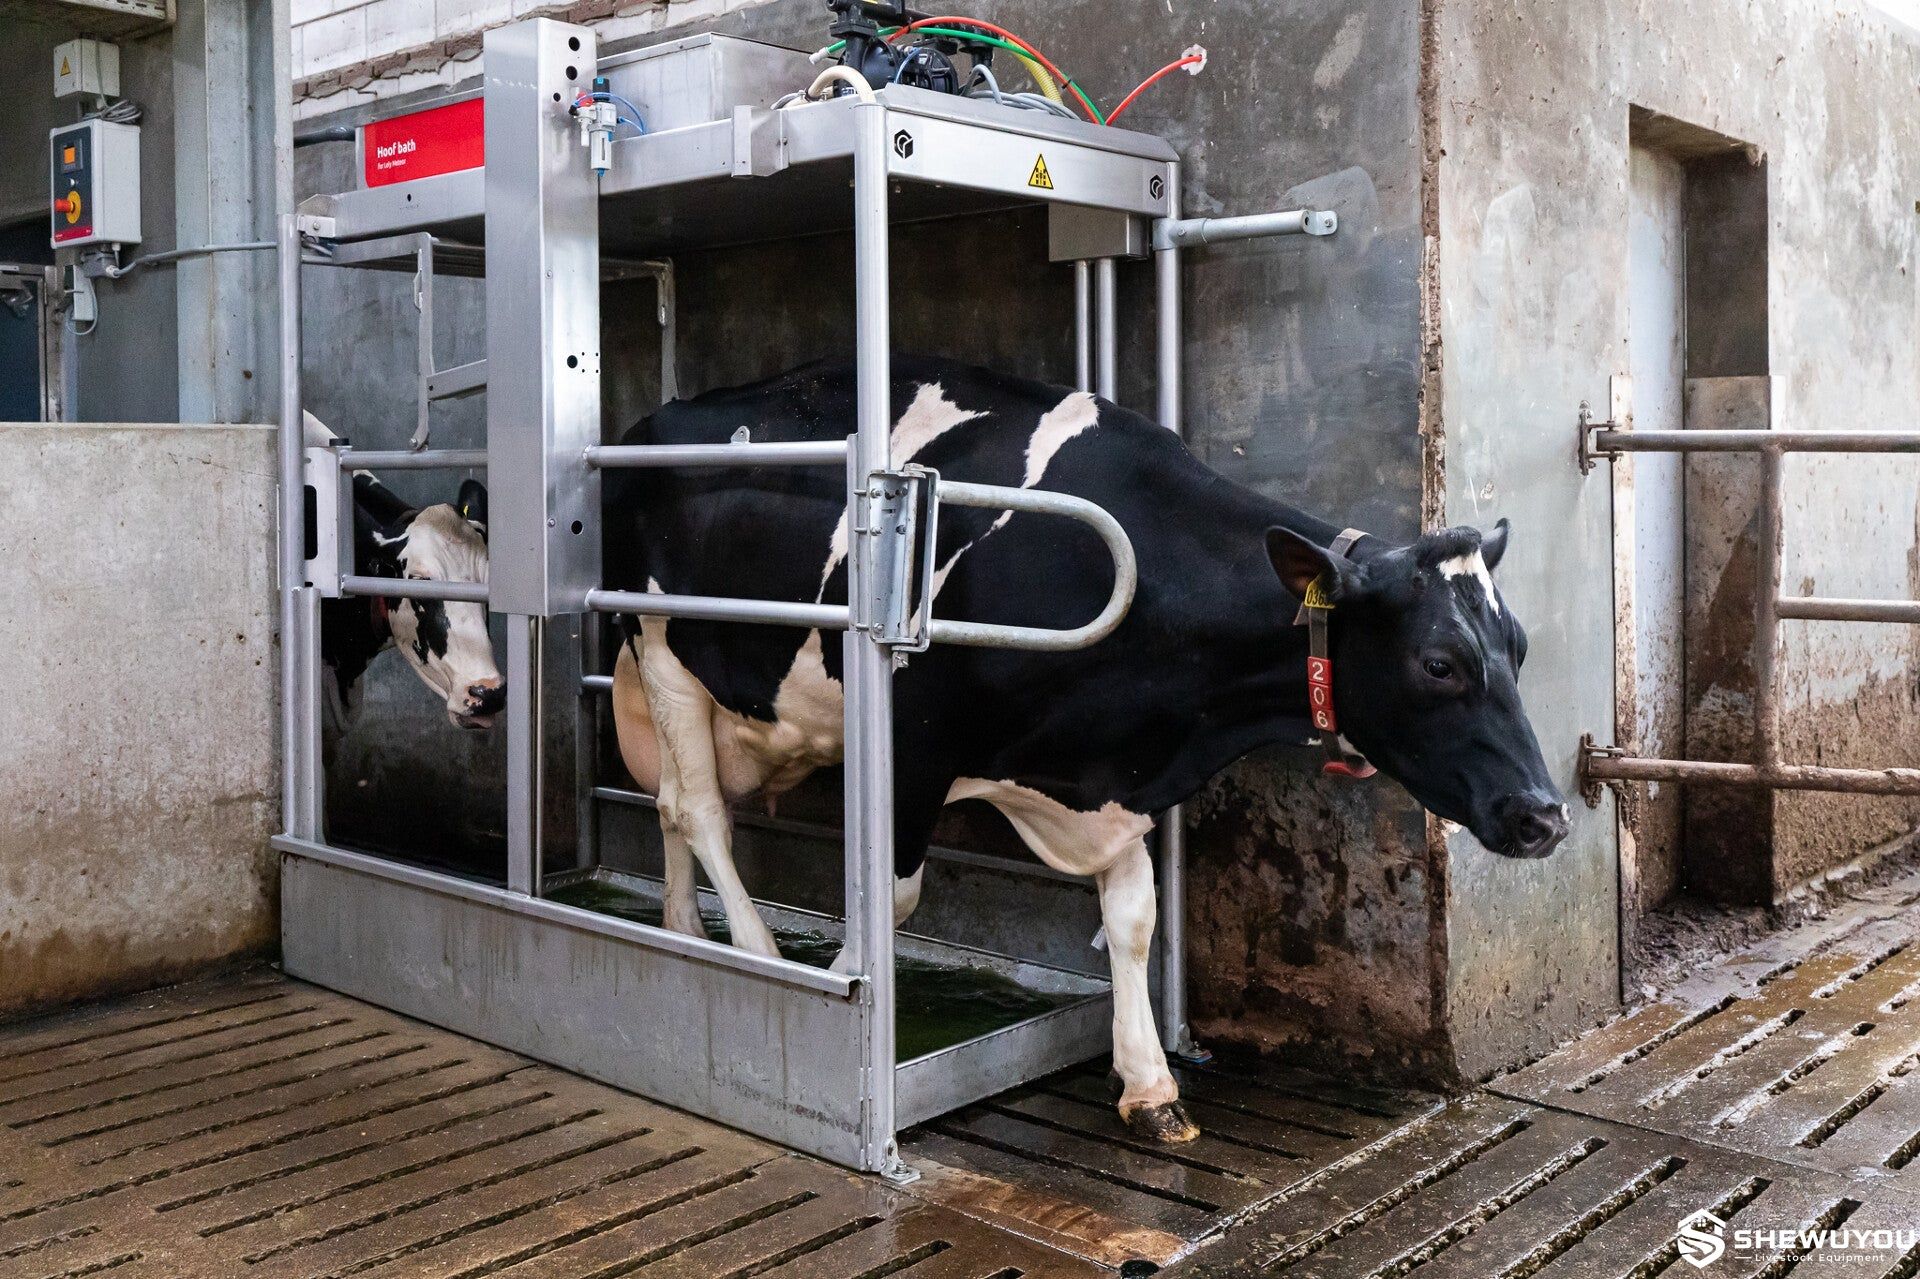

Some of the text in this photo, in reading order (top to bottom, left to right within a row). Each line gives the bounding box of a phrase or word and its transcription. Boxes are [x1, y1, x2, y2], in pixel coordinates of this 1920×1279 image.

[377, 139, 416, 158] Hoof bath
[1312, 661, 1329, 728] 206
